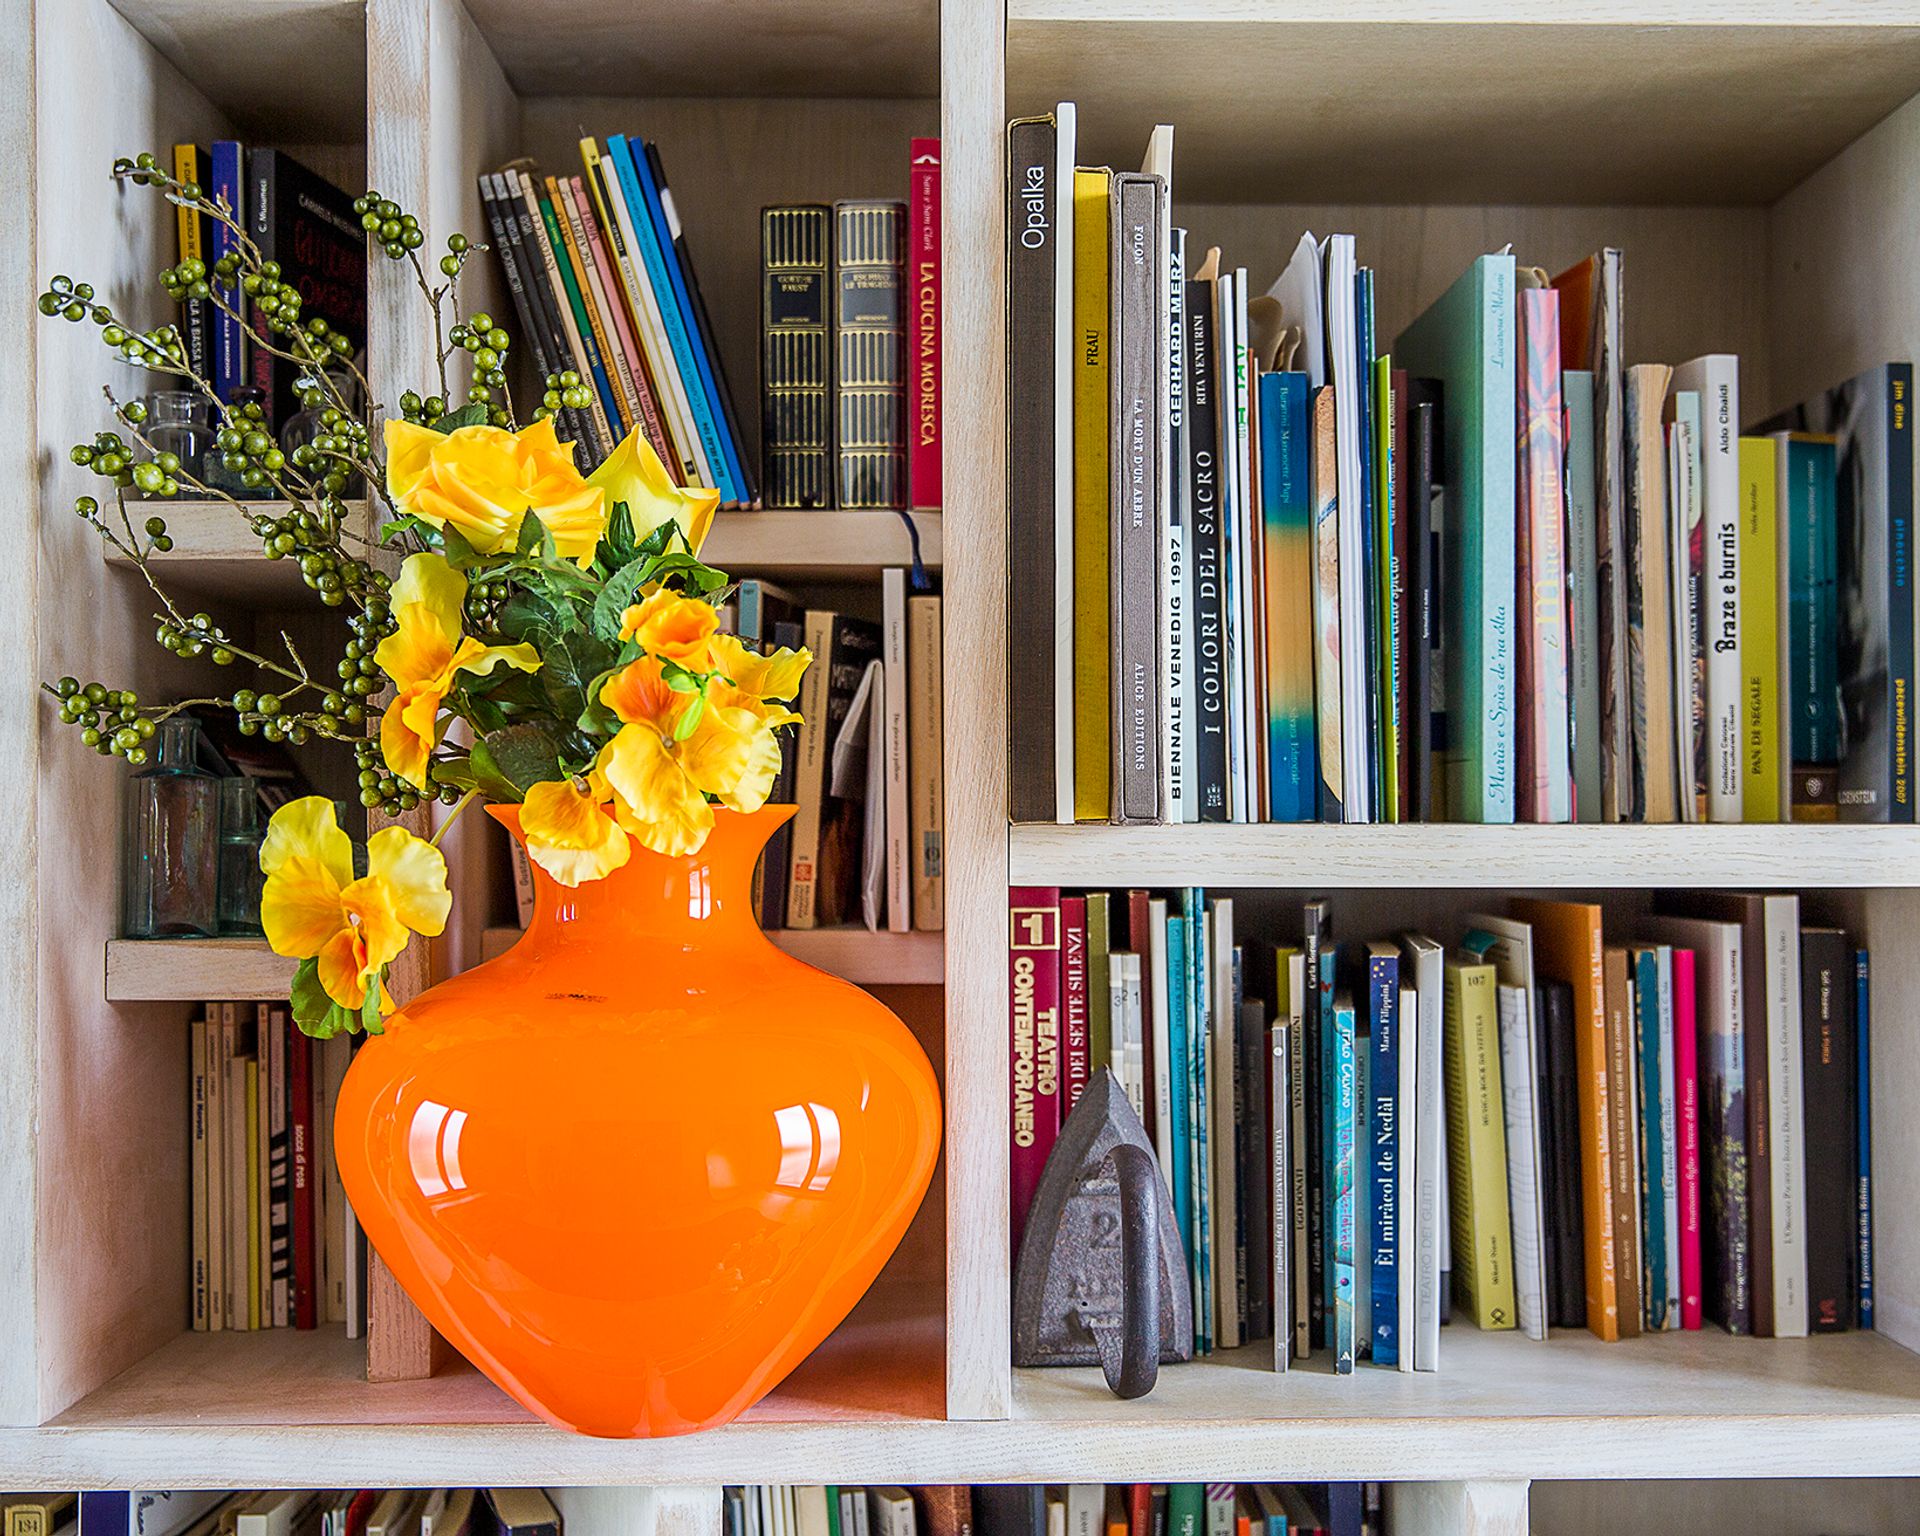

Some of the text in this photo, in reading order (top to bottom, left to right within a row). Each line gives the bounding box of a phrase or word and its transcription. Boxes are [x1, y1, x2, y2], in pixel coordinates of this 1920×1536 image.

[258, 180, 267, 222] Musumeci
[923, 175, 934, 194] Sam
[924, 204, 934, 224] Sam
[1021, 168, 1048, 251] Opalka
[924, 226, 934, 251] Clark
[1133, 225, 1144, 265] FOLON
[781, 284, 810, 292] FAUST
[191, 326, 203, 357] BASSA
[920, 262, 936, 447] LA CUCINA MORESCA
[1086, 328, 1099, 366] FRAU
[1170, 253, 1182, 428] GERHARD MERZ
[1193, 316, 1207, 405] RITA VENTURINI
[1133, 400, 1143, 414] LA
[1280, 387, 1290, 427] Burattini
[1719, 384, 1729, 455] Aldo Cibaldi
[1893, 380, 1904, 429] jim dine
[1133, 419, 1143, 452] MORT
[1280, 430, 1290, 478] Marionette
[1133, 488, 1144, 528] ARBRE
[1196, 451, 1213, 535] SACRO
[1198, 548, 1216, 598] DEL
[1893, 518, 1906, 587] pinocchio
[1542, 634, 1559, 648] i
[1714, 585, 1736, 653] Braze e
[1170, 539, 1182, 800] BIENNALE VENEDIG 1997
[1201, 613, 1219, 712] COLORI
[1134, 664, 1146, 770] ALICE EDITIONS
[1750, 676, 1761, 774] PAN DI SEGALE
[1894, 678, 1907, 804] pacewildenstein 2007
[1291, 742, 1300, 786] Editoriale
[1021, 914, 1043, 945] 1
[1308, 965, 1317, 989] Carla
[1067, 927, 1083, 1080] DEI SETTE SILENZI
[1114, 996, 1121, 1008] 3
[1380, 984, 1393, 1053] Maria Filippini
[1013, 956, 1035, 1148] CONTEMPORANEO
[1037, 1007, 1057, 1096] TEATRO
[1292, 1016, 1302, 1109] VENTIDUE DISEGNI
[1341, 1028, 1353, 1109] ITALO CALVINO
[1357, 1084, 1365, 1126] FORMICHE
[1377, 1096, 1393, 1145] Nedàl
[1378, 1153, 1393, 1172] de
[1275, 1129, 1284, 1274] VALERIO EVANGELISTI Day Hospital
[1296, 1168, 1305, 1230] UGO DONATI
[1378, 1177, 1393, 1243] miràcol
[1422, 1227, 1432, 1249] DEI
[1860, 1212, 1868, 1237] della
[1422, 1254, 1432, 1307] TEATRO
[1422, 1311, 1432, 1323] IL
